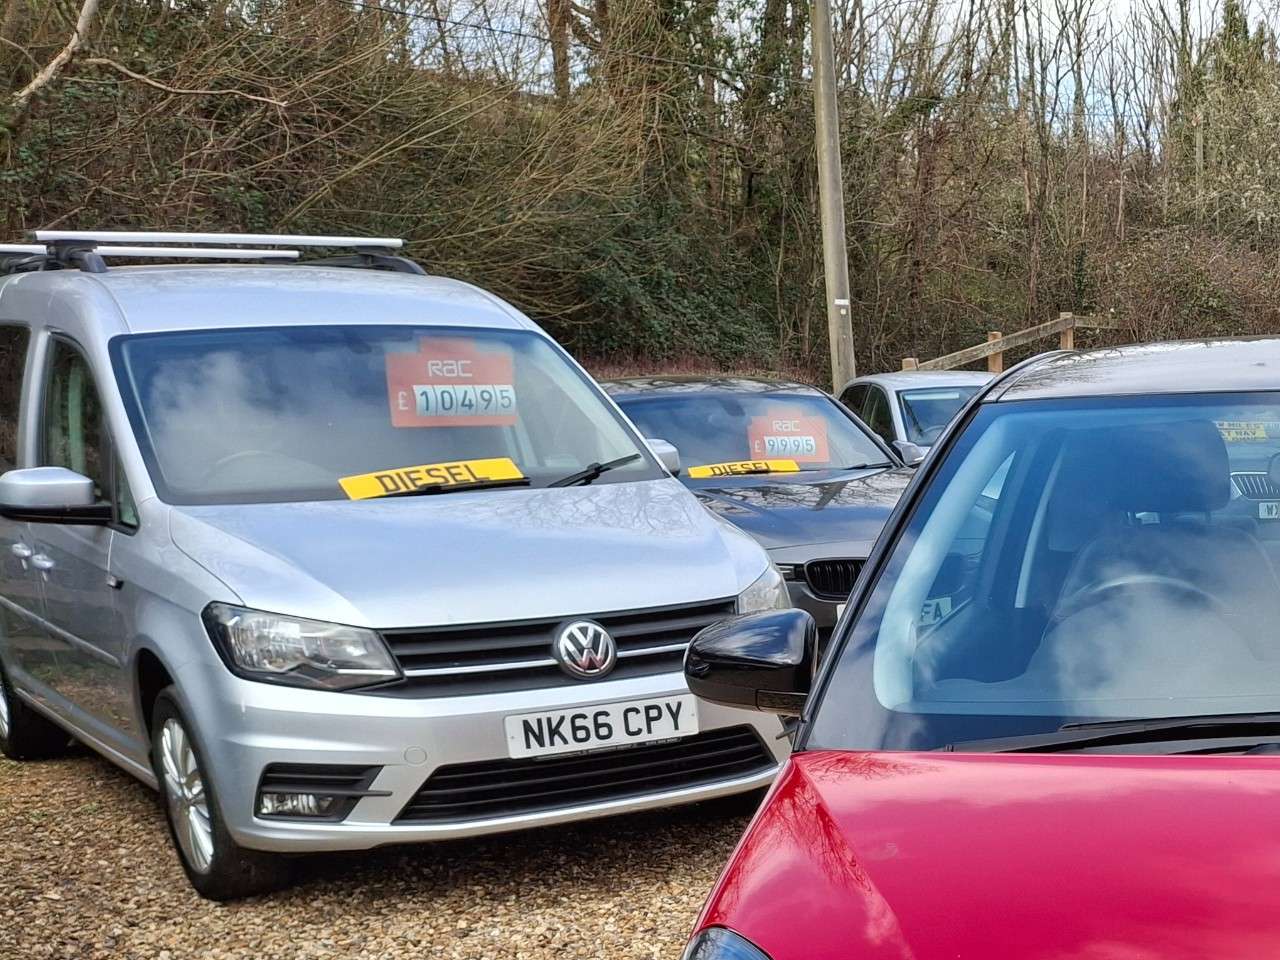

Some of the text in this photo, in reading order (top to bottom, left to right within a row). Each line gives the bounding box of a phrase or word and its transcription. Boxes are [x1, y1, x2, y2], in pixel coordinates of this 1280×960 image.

[374, 463, 490, 493] DIESEL
[522, 710, 613, 750] NK66
[622, 701, 682, 737] CPY
